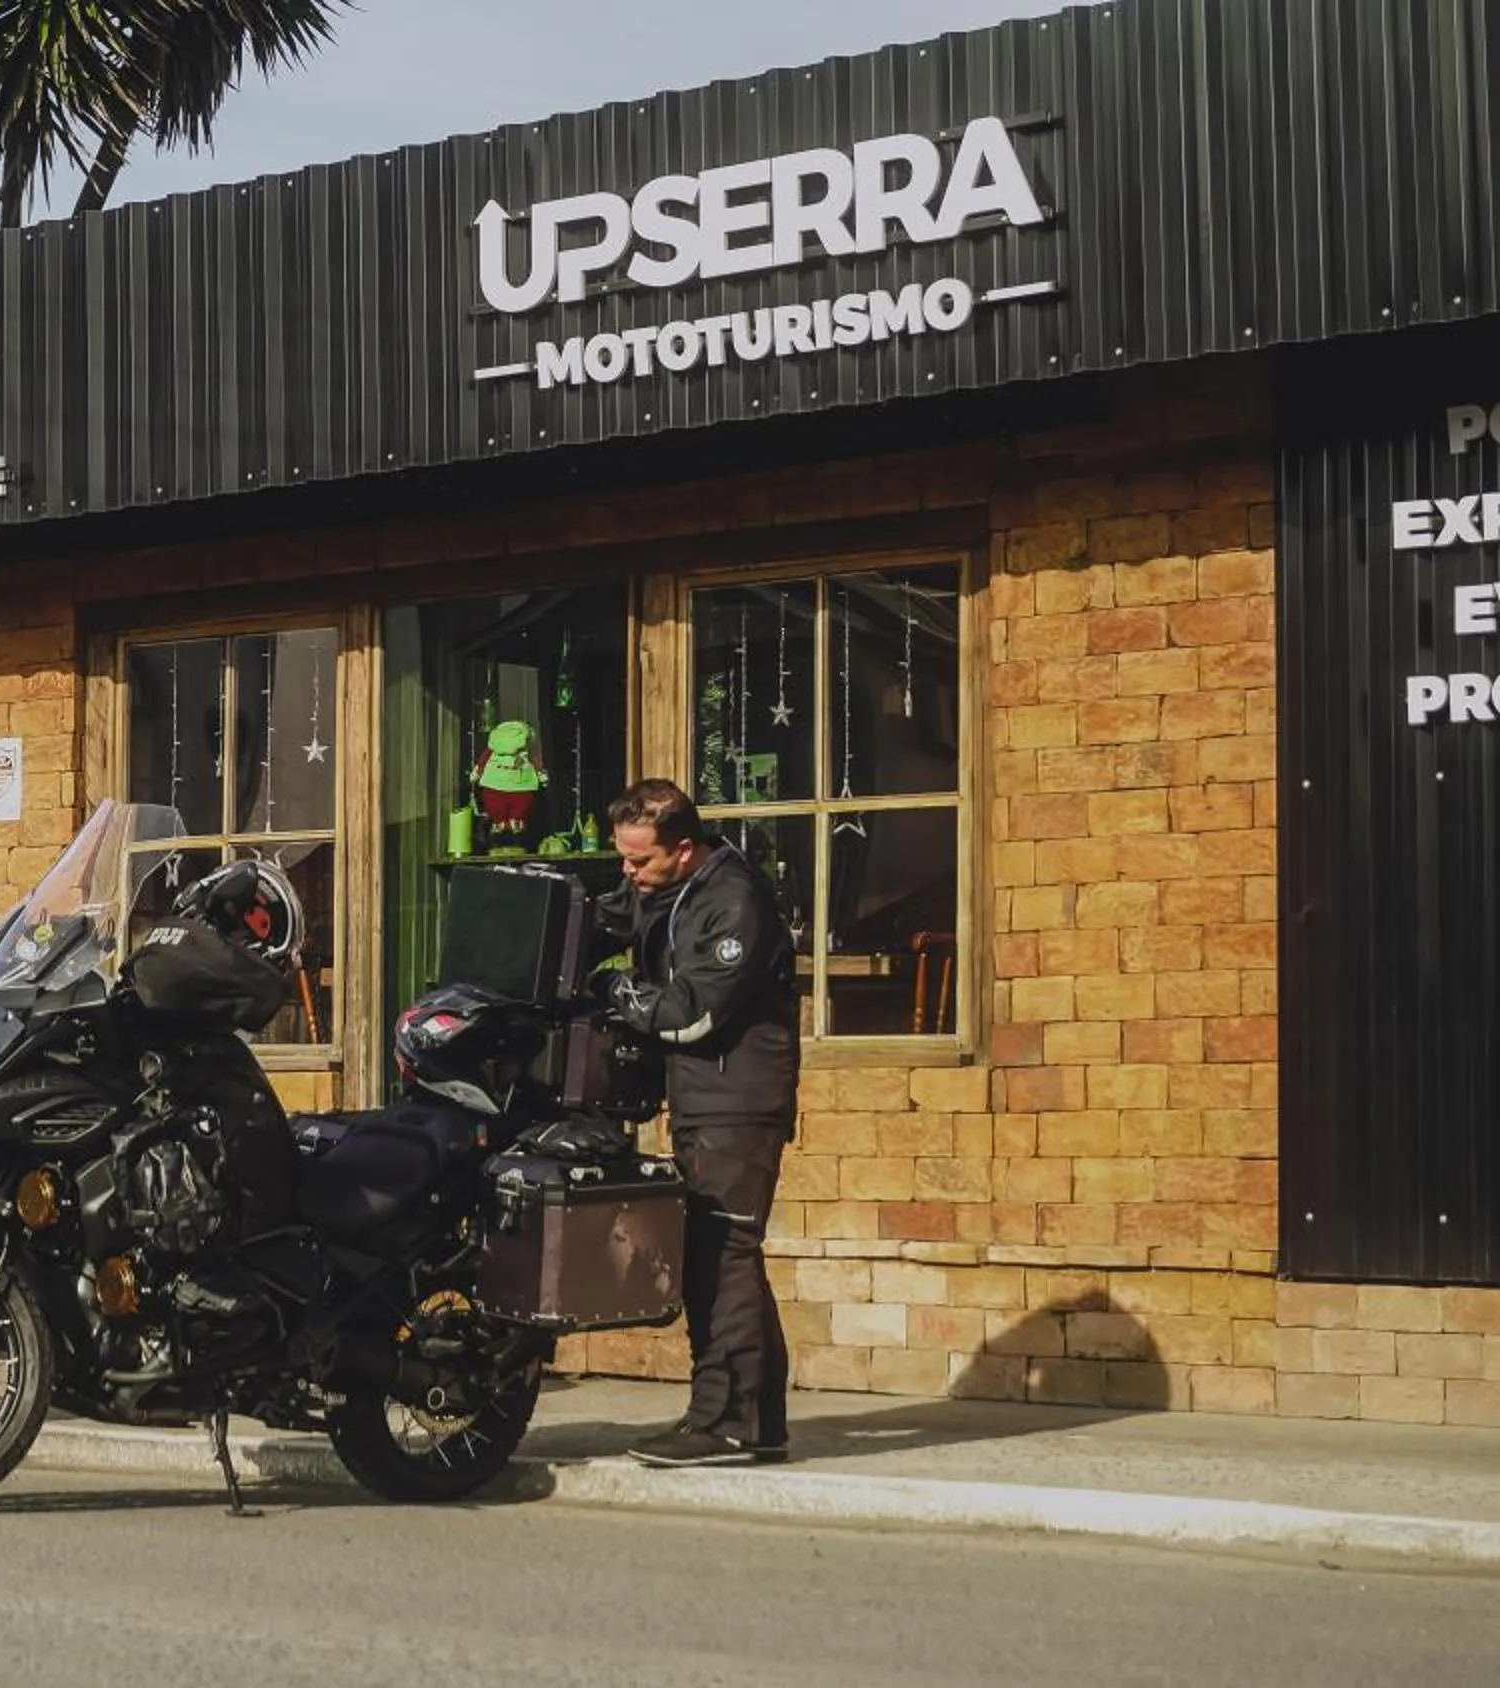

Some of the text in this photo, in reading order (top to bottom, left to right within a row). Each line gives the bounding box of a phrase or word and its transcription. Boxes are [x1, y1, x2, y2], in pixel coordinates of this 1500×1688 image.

[536, 278, 973, 389] MOTOTURISMO
[1447, 402, 1500, 454] P
[1455, 582, 1500, 634] E
[1407, 673, 1500, 725] PR
